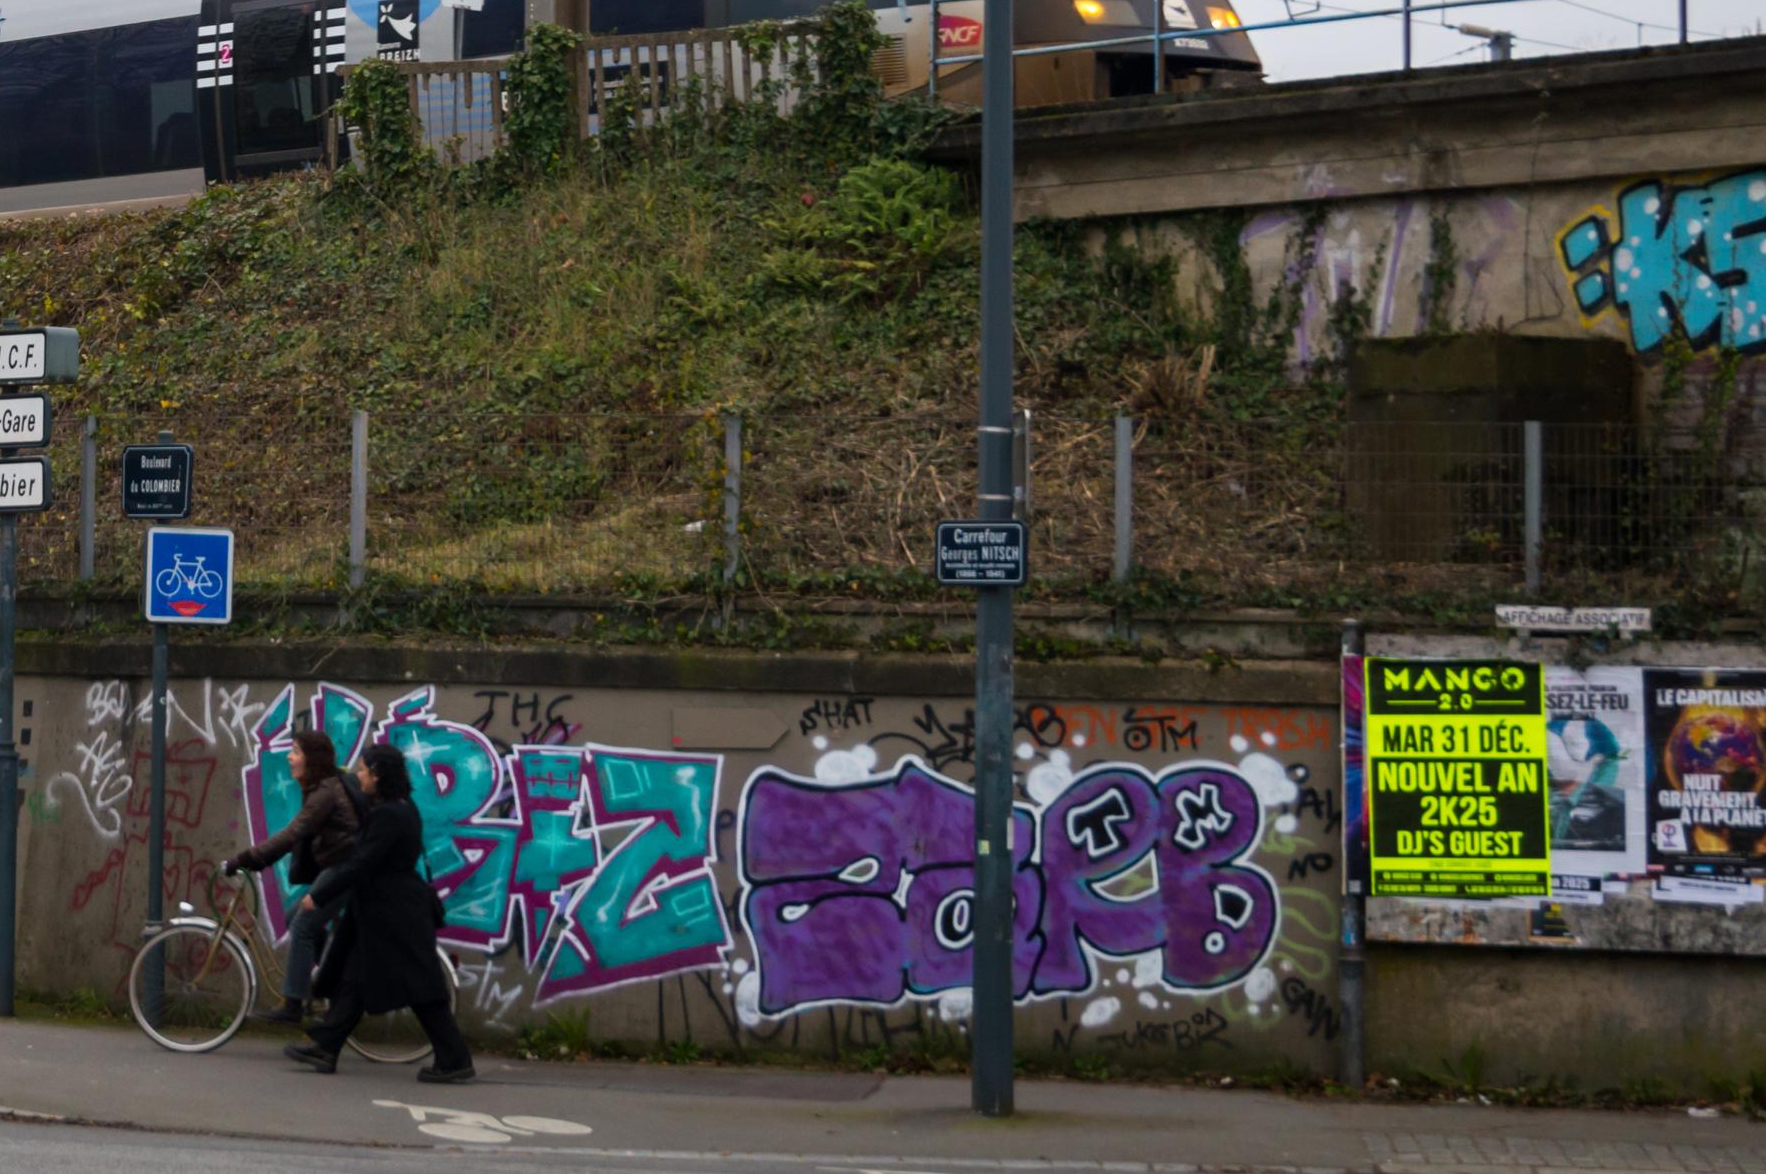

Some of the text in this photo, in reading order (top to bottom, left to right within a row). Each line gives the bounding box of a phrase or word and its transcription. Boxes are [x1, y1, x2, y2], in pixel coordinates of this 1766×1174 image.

[141, 455, 172, 468] Boulevard
[141, 479, 181, 493] COLOMBIER
[954, 528, 1008, 543] Carrefour
[941, 546, 1019, 564] Georges NITSCH
[1502, 611, 1572, 625] AFFICHAGE
[1385, 667, 1526, 691] MANGO
[1439, 693, 1473, 709] 2.0
[1657, 689, 1674, 706] LE
[799, 698, 875, 735] SHAT
[1384, 720, 1531, 752] MAR 31 DÉC.
[1378, 762, 1538, 792] NOUVEL AN
[1683, 774, 1722, 790] NUIT
[1420, 796, 1498, 826] 2K25
[1397, 830, 1523, 856] DJ'S GUEST
